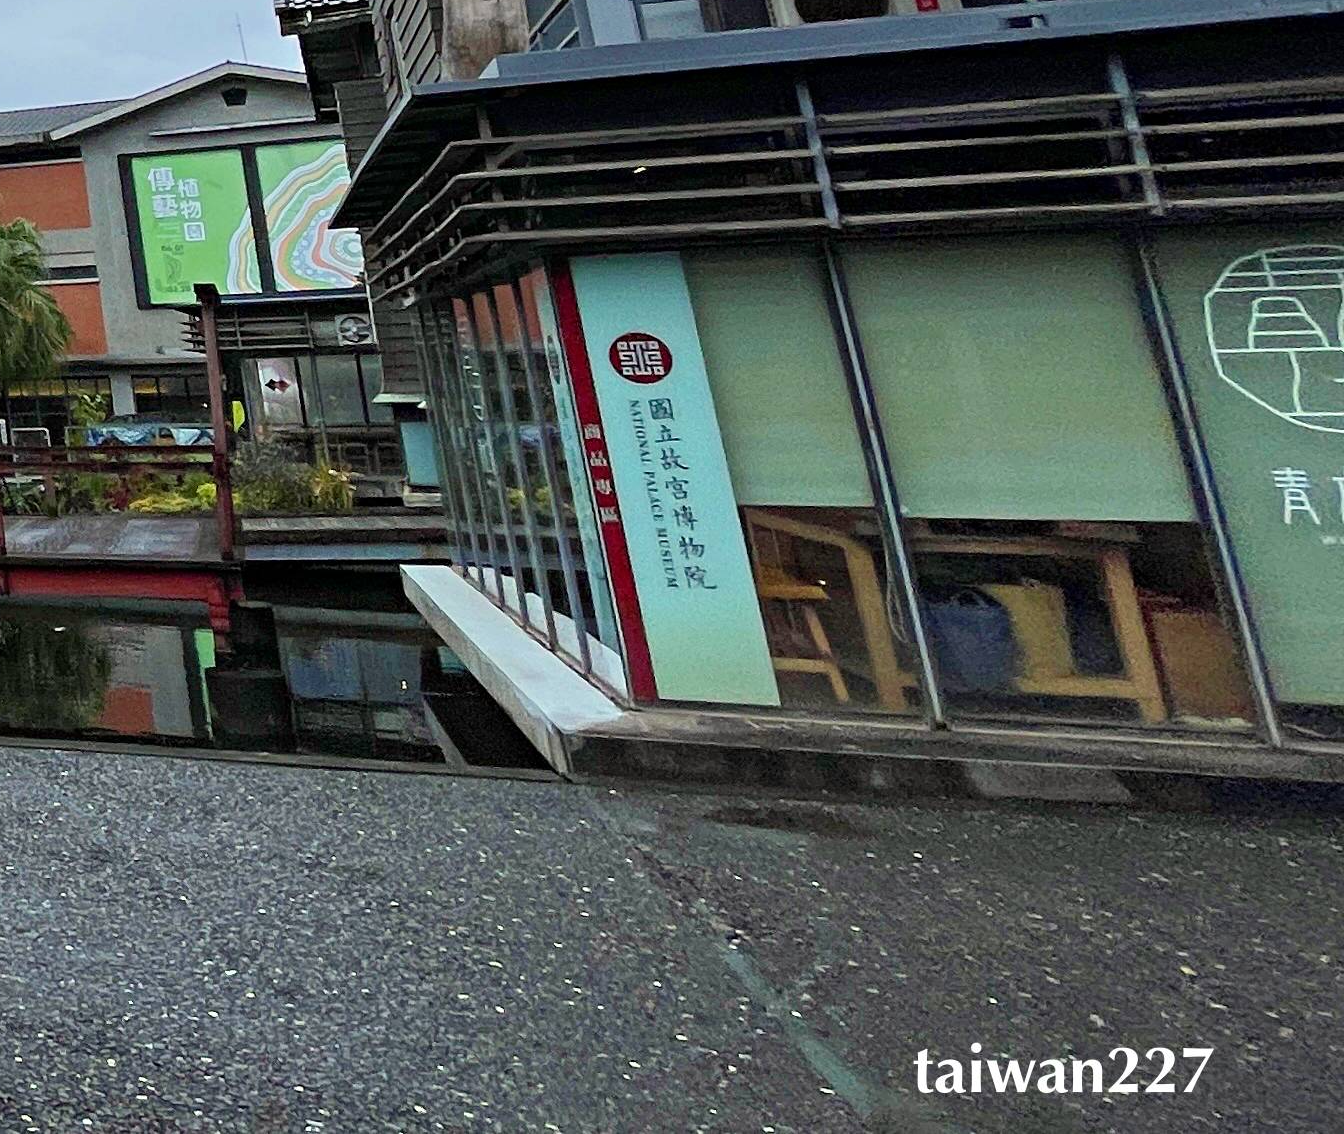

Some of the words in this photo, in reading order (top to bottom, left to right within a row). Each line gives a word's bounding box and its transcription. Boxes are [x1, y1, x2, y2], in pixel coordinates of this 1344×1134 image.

[629, 398, 653, 465] NATIONAL
[643, 470, 665, 523] PALACE
[656, 527, 679, 589] MUSEUM
[648, 397, 718, 590] 國立故宮博物院
